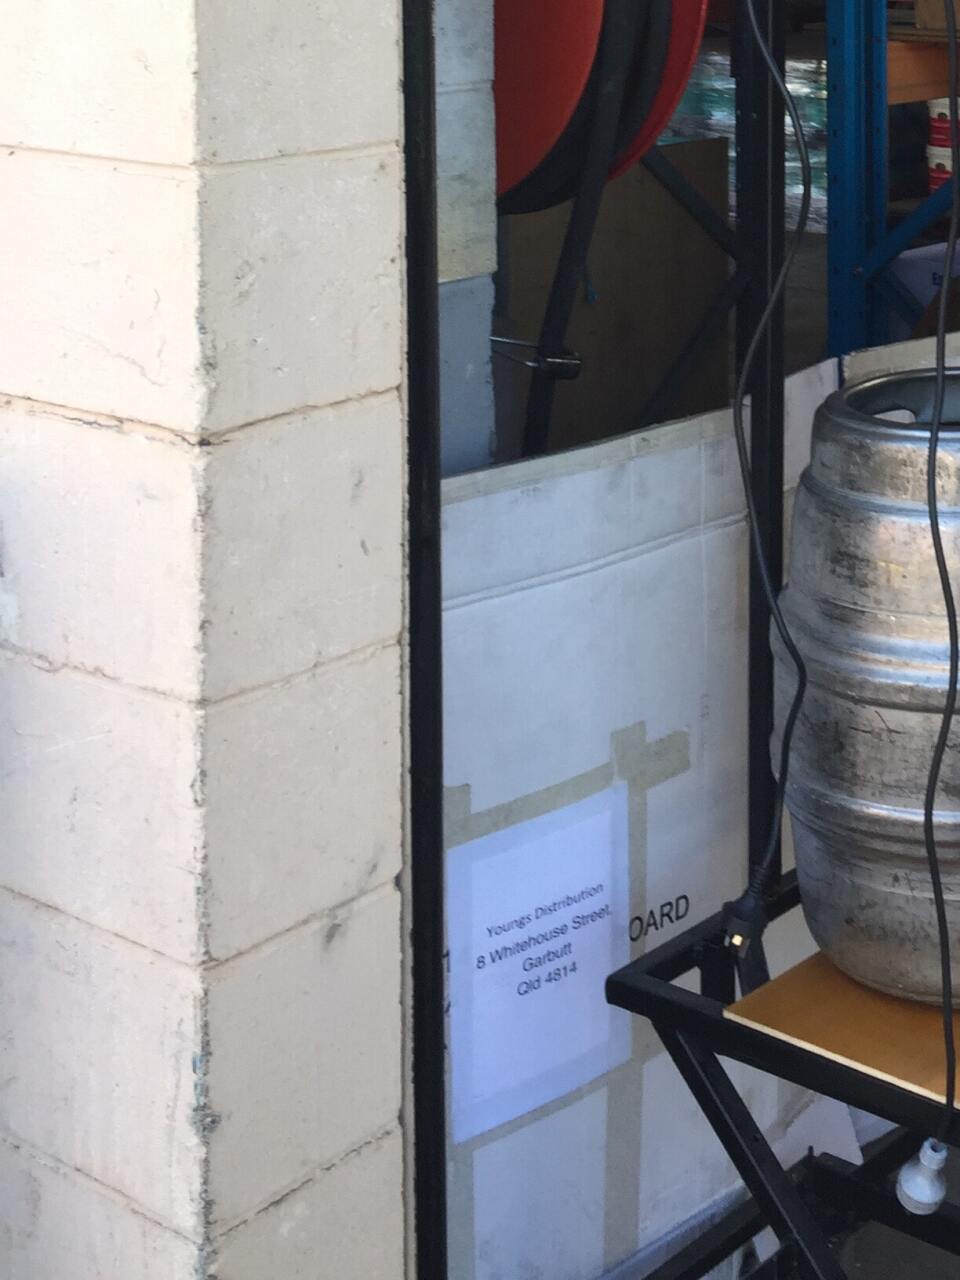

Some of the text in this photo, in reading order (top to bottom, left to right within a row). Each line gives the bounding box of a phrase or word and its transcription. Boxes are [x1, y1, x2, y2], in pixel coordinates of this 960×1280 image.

[487, 883, 604, 939] Youngs Distribution
[628, 894, 690, 943] OARD
[476, 955, 486, 970] 8
[490, 924, 569, 966] Whitehouse
[522, 942, 573, 973] Garbutt
[516, 961, 579, 997] Qld 4814
